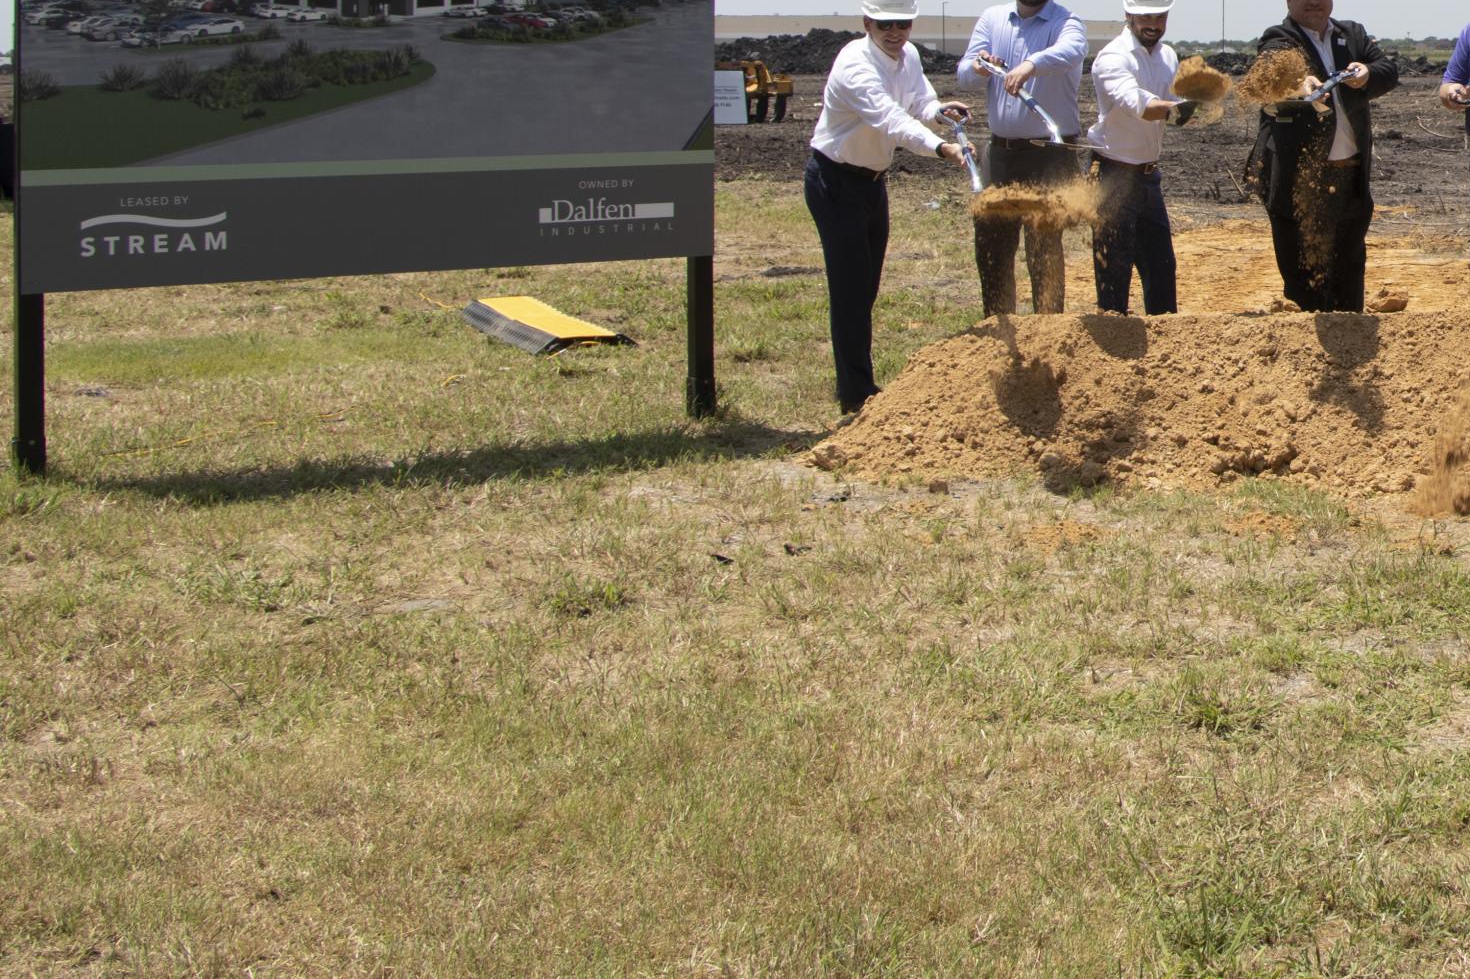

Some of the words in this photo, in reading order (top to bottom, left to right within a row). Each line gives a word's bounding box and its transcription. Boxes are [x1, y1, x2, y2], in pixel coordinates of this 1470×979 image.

[578, 179, 618, 190] OWNED
[621, 179, 634, 188] BY
[119, 196, 169, 208] LEASED
[173, 195, 189, 205] BY
[551, 196, 634, 222] Dalfen
[538, 220, 674, 237] INDUSTRIAL
[79, 230, 228, 258] STREAM
